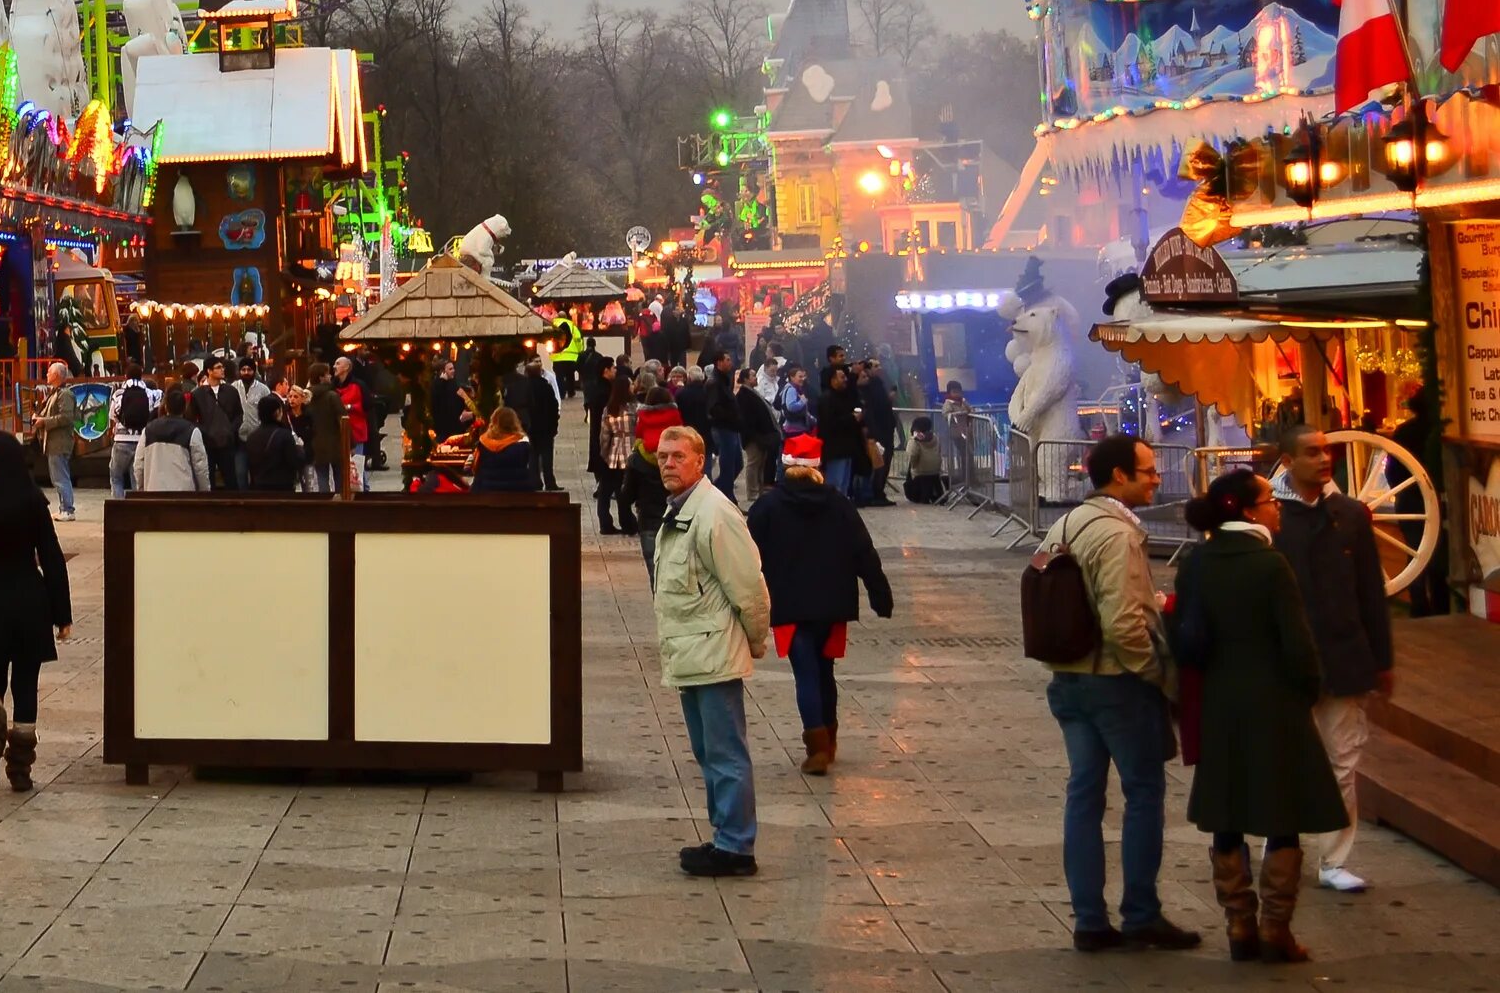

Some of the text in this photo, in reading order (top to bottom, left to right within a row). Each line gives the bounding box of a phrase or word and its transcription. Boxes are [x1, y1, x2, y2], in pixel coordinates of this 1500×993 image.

[1457, 232, 1495, 244] Gourmet
[1481, 244, 1500, 256] Bur
[1466, 301, 1500, 329] Chi
[1469, 387, 1486, 400] Tea
[1470, 407, 1486, 422] Hot
